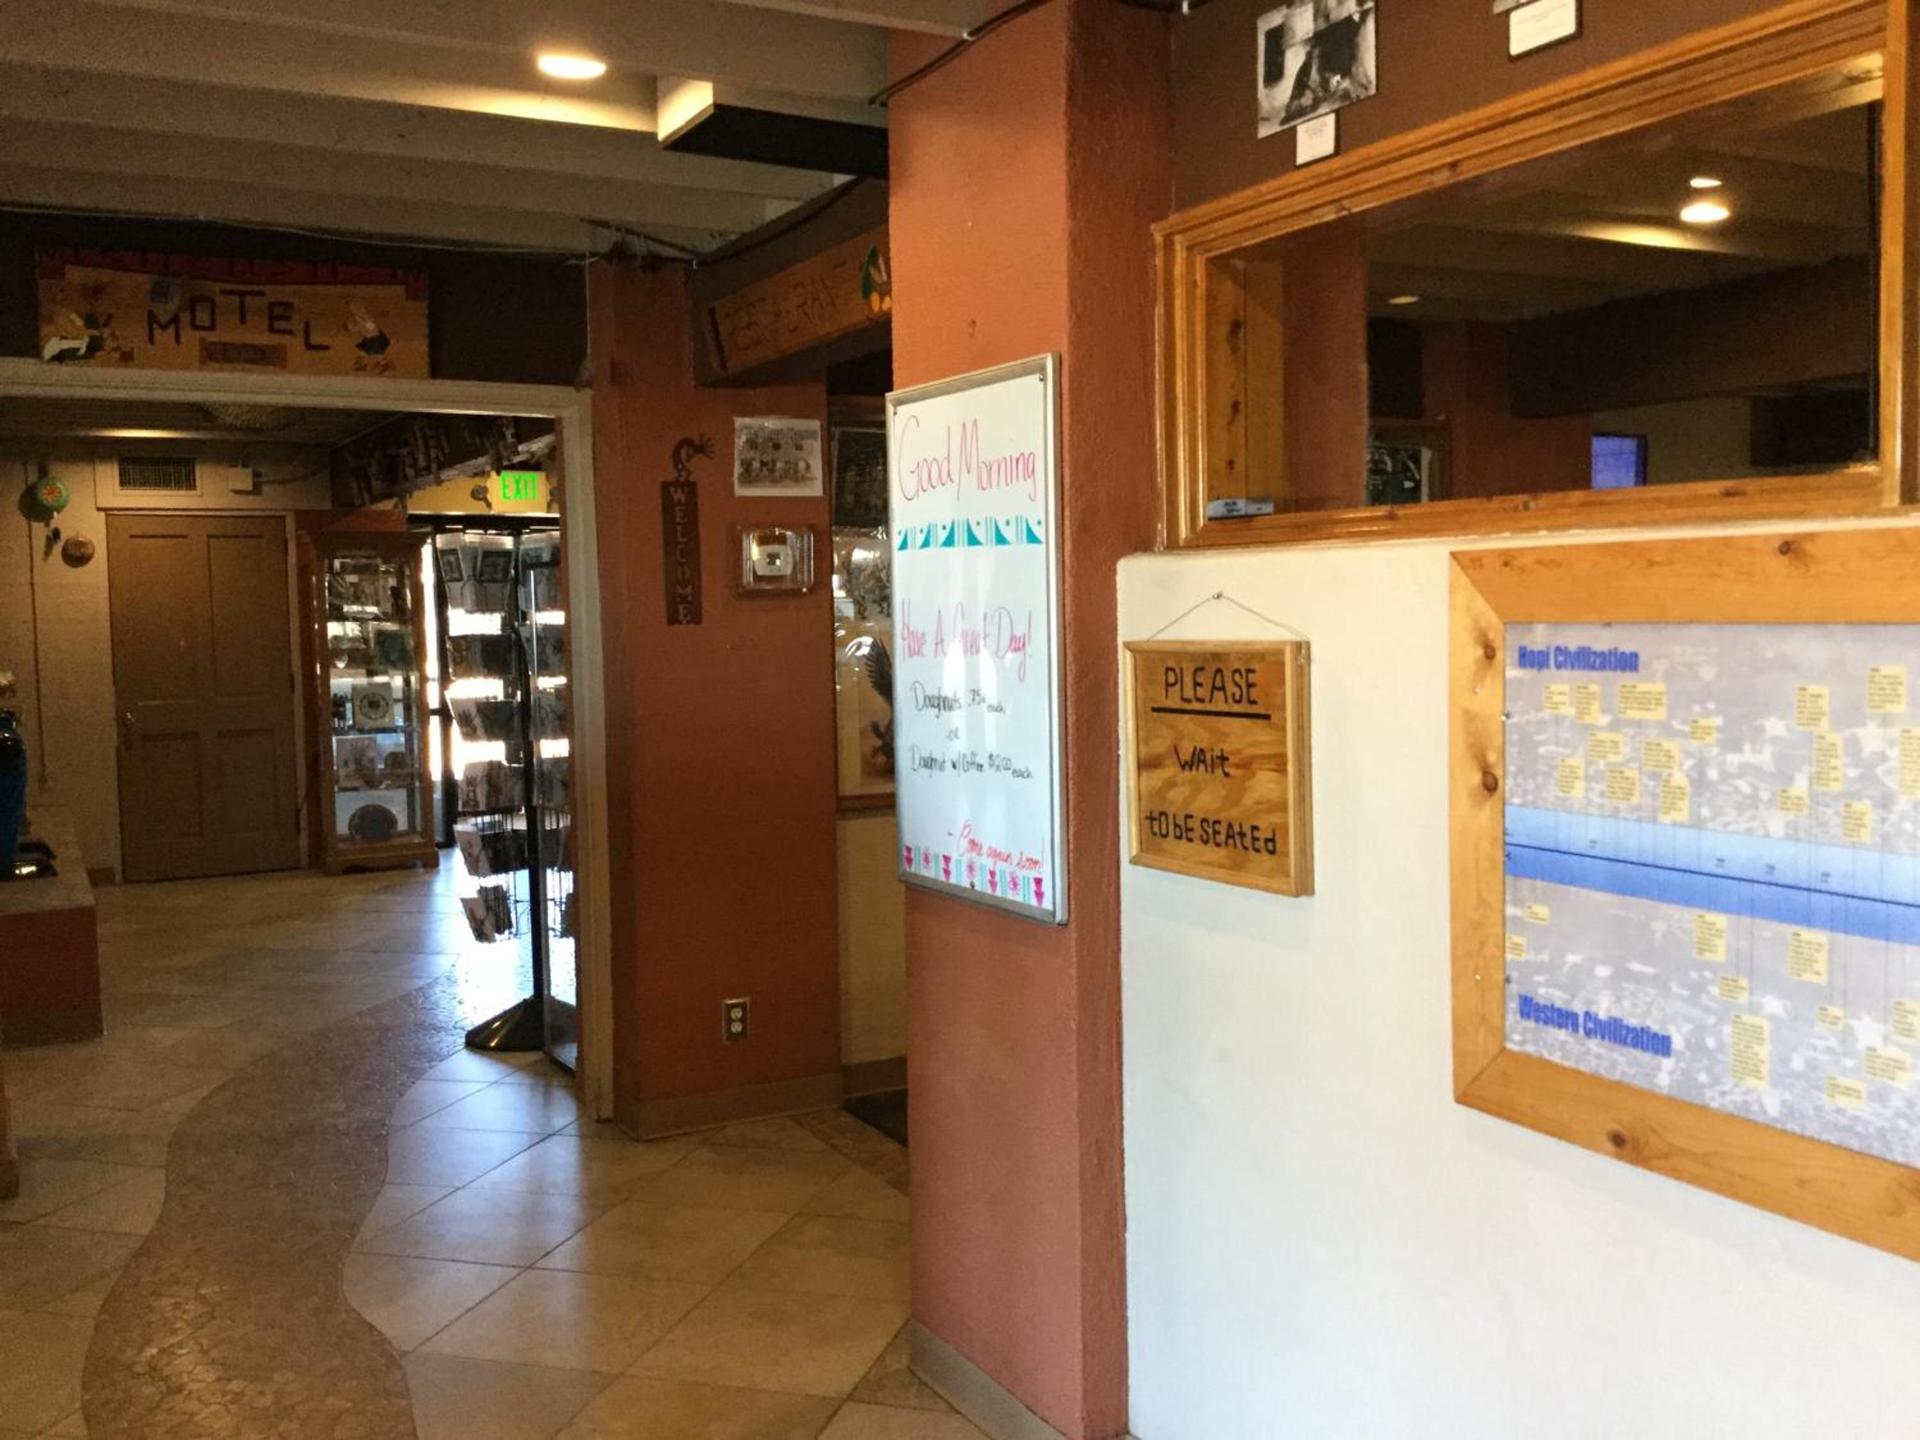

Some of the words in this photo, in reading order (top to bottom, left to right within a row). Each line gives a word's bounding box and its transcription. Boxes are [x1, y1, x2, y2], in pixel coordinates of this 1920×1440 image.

[147, 288, 331, 352] MOTEL
[501, 471, 538, 501] EXIT
[898, 414, 954, 502] Good
[956, 417, 1036, 502] Morning
[669, 485, 694, 621] WELCOME
[933, 608, 947, 658] A
[991, 606, 1033, 683] Day!
[1518, 645, 1550, 672] Hopi
[1554, 645, 1639, 673] Civilization
[1164, 667, 1258, 705] PLEASE
[1518, 994, 1579, 1034] Western
[1583, 1010, 1672, 1059] Civilization
